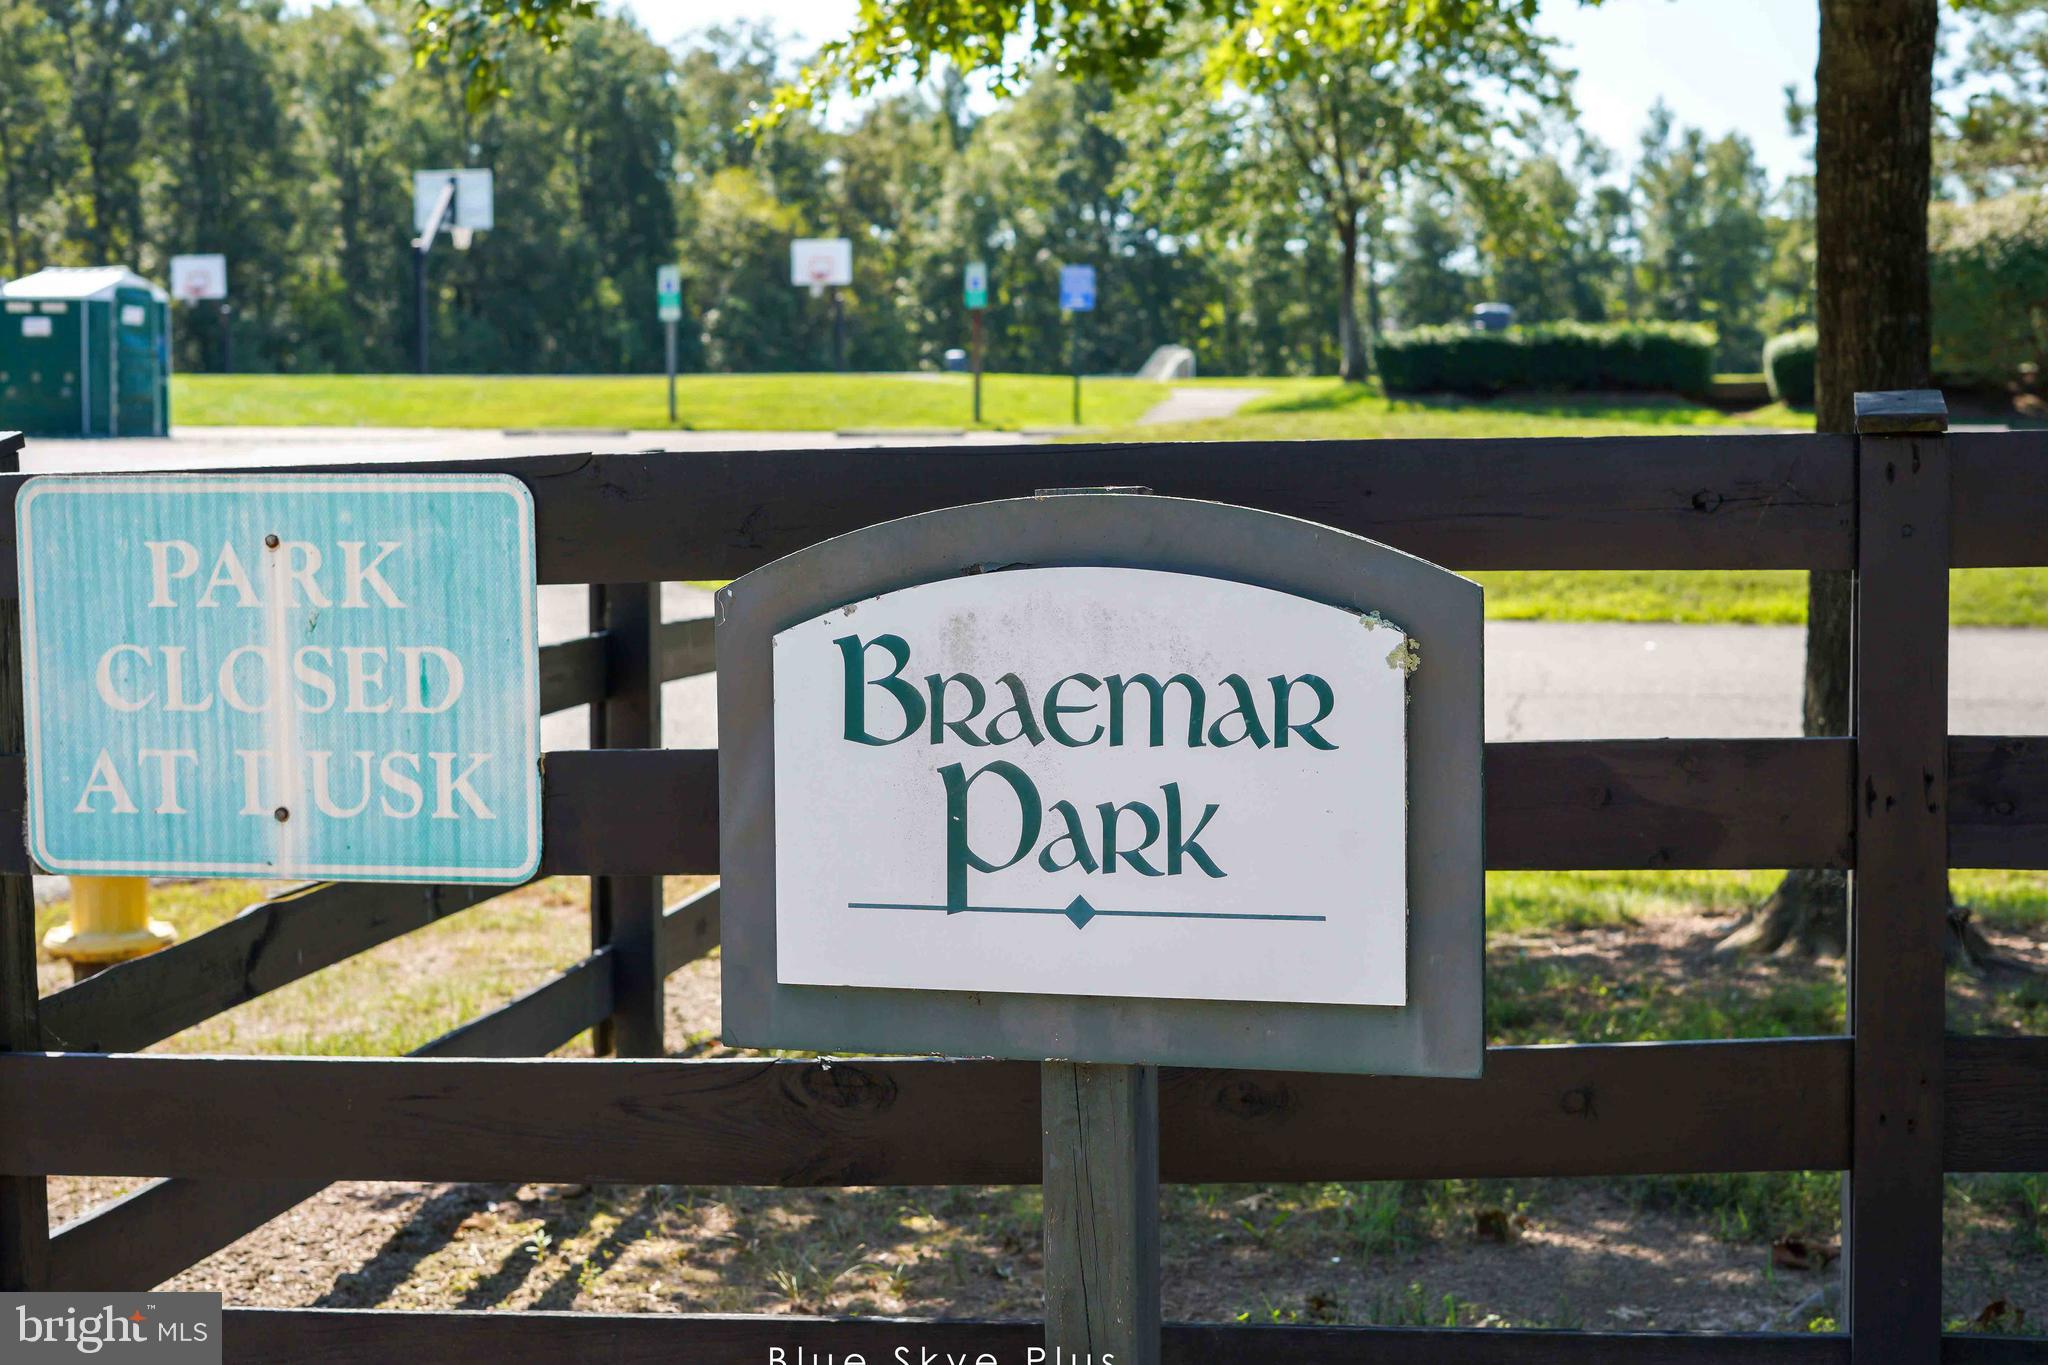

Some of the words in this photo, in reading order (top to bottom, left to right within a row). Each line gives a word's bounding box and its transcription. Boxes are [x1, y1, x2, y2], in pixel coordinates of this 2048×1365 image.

[145, 540, 408, 610] PARK
[96, 644, 465, 715] CLOSED
[74, 747, 199, 815] AT
